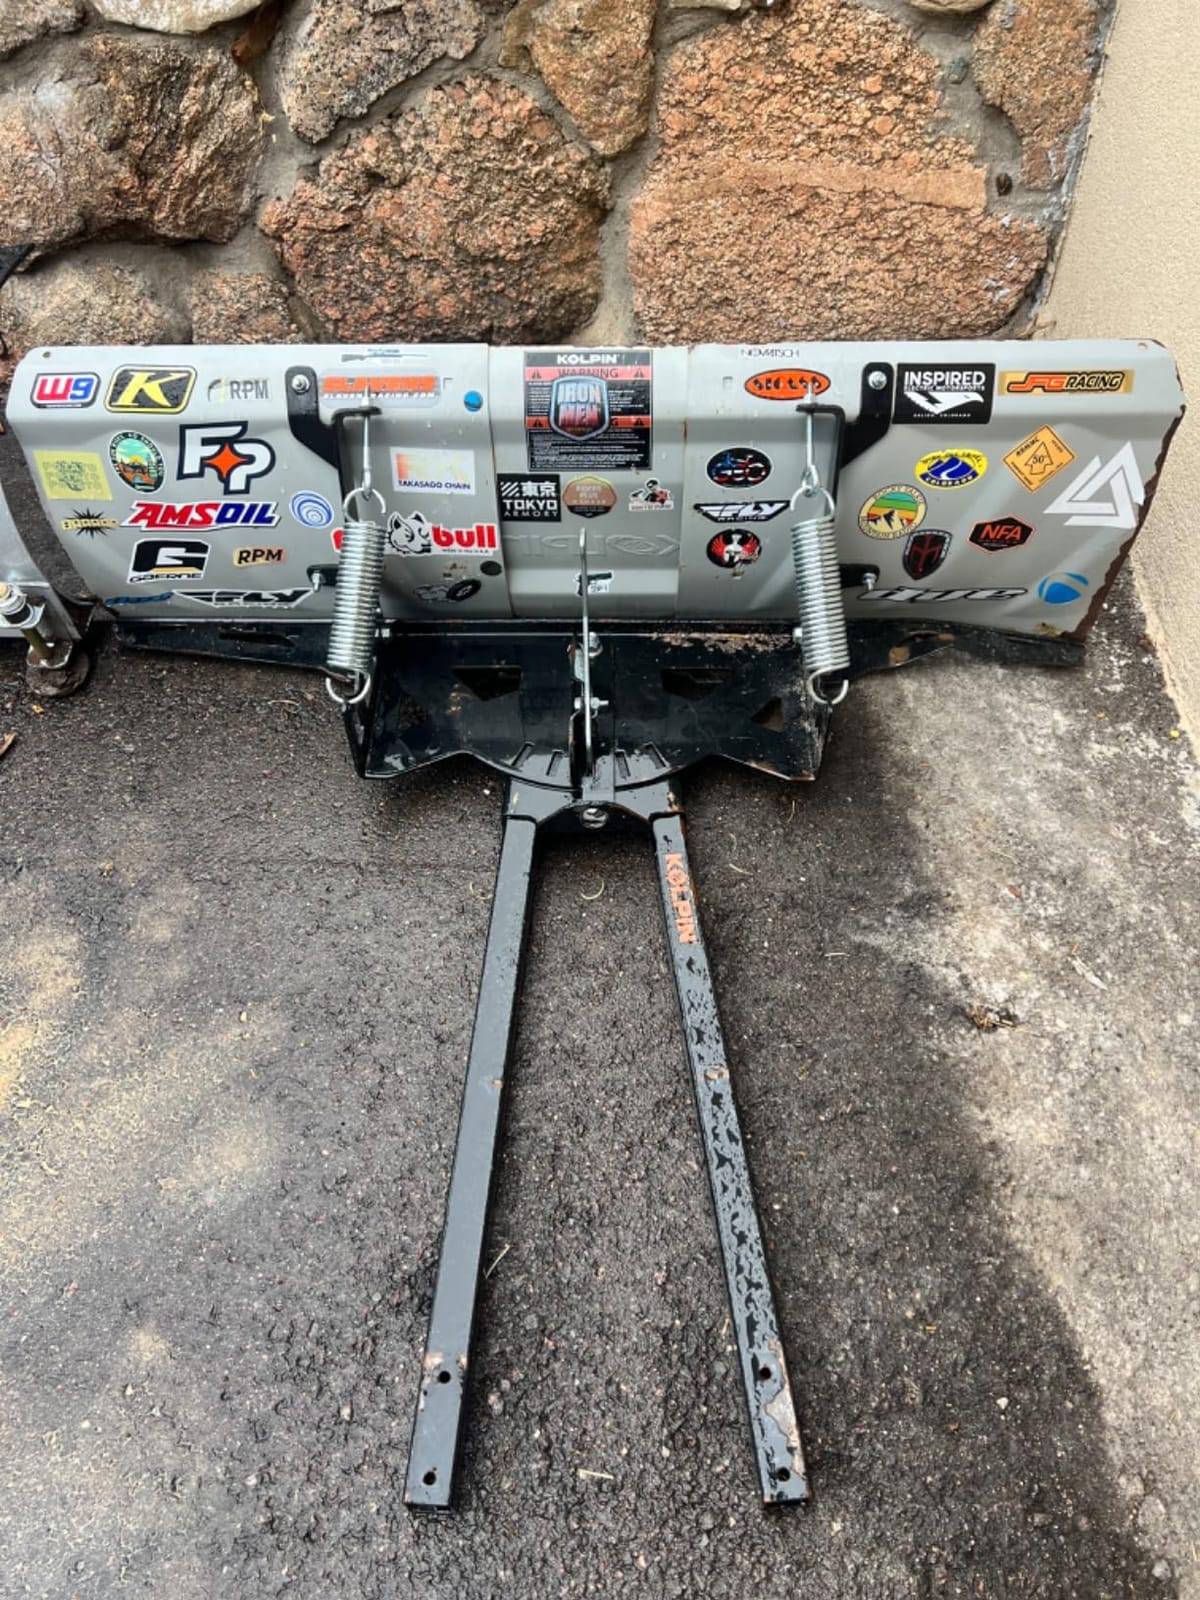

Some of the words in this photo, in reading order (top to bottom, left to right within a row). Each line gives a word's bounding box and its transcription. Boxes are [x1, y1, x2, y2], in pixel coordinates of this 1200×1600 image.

[556, 354, 618, 365] KOLPIN
[558, 368, 619, 379] WARNING
[904, 371, 986, 386] INSPIRED
[1065, 374, 1122, 389] RACING
[230, 379, 269, 400] RPM
[557, 382, 601, 406] IRON
[398, 479, 443, 489] TAKASAGO
[444, 481, 471, 490] CHAIN
[521, 481, 557, 497] 東京
[503, 500, 558, 510] TOKYO
[129, 502, 277, 527] AMSOIL
[431, 524, 497, 549] bull
[980, 523, 1022, 541] NFA
[237, 548, 284, 566] RPM
